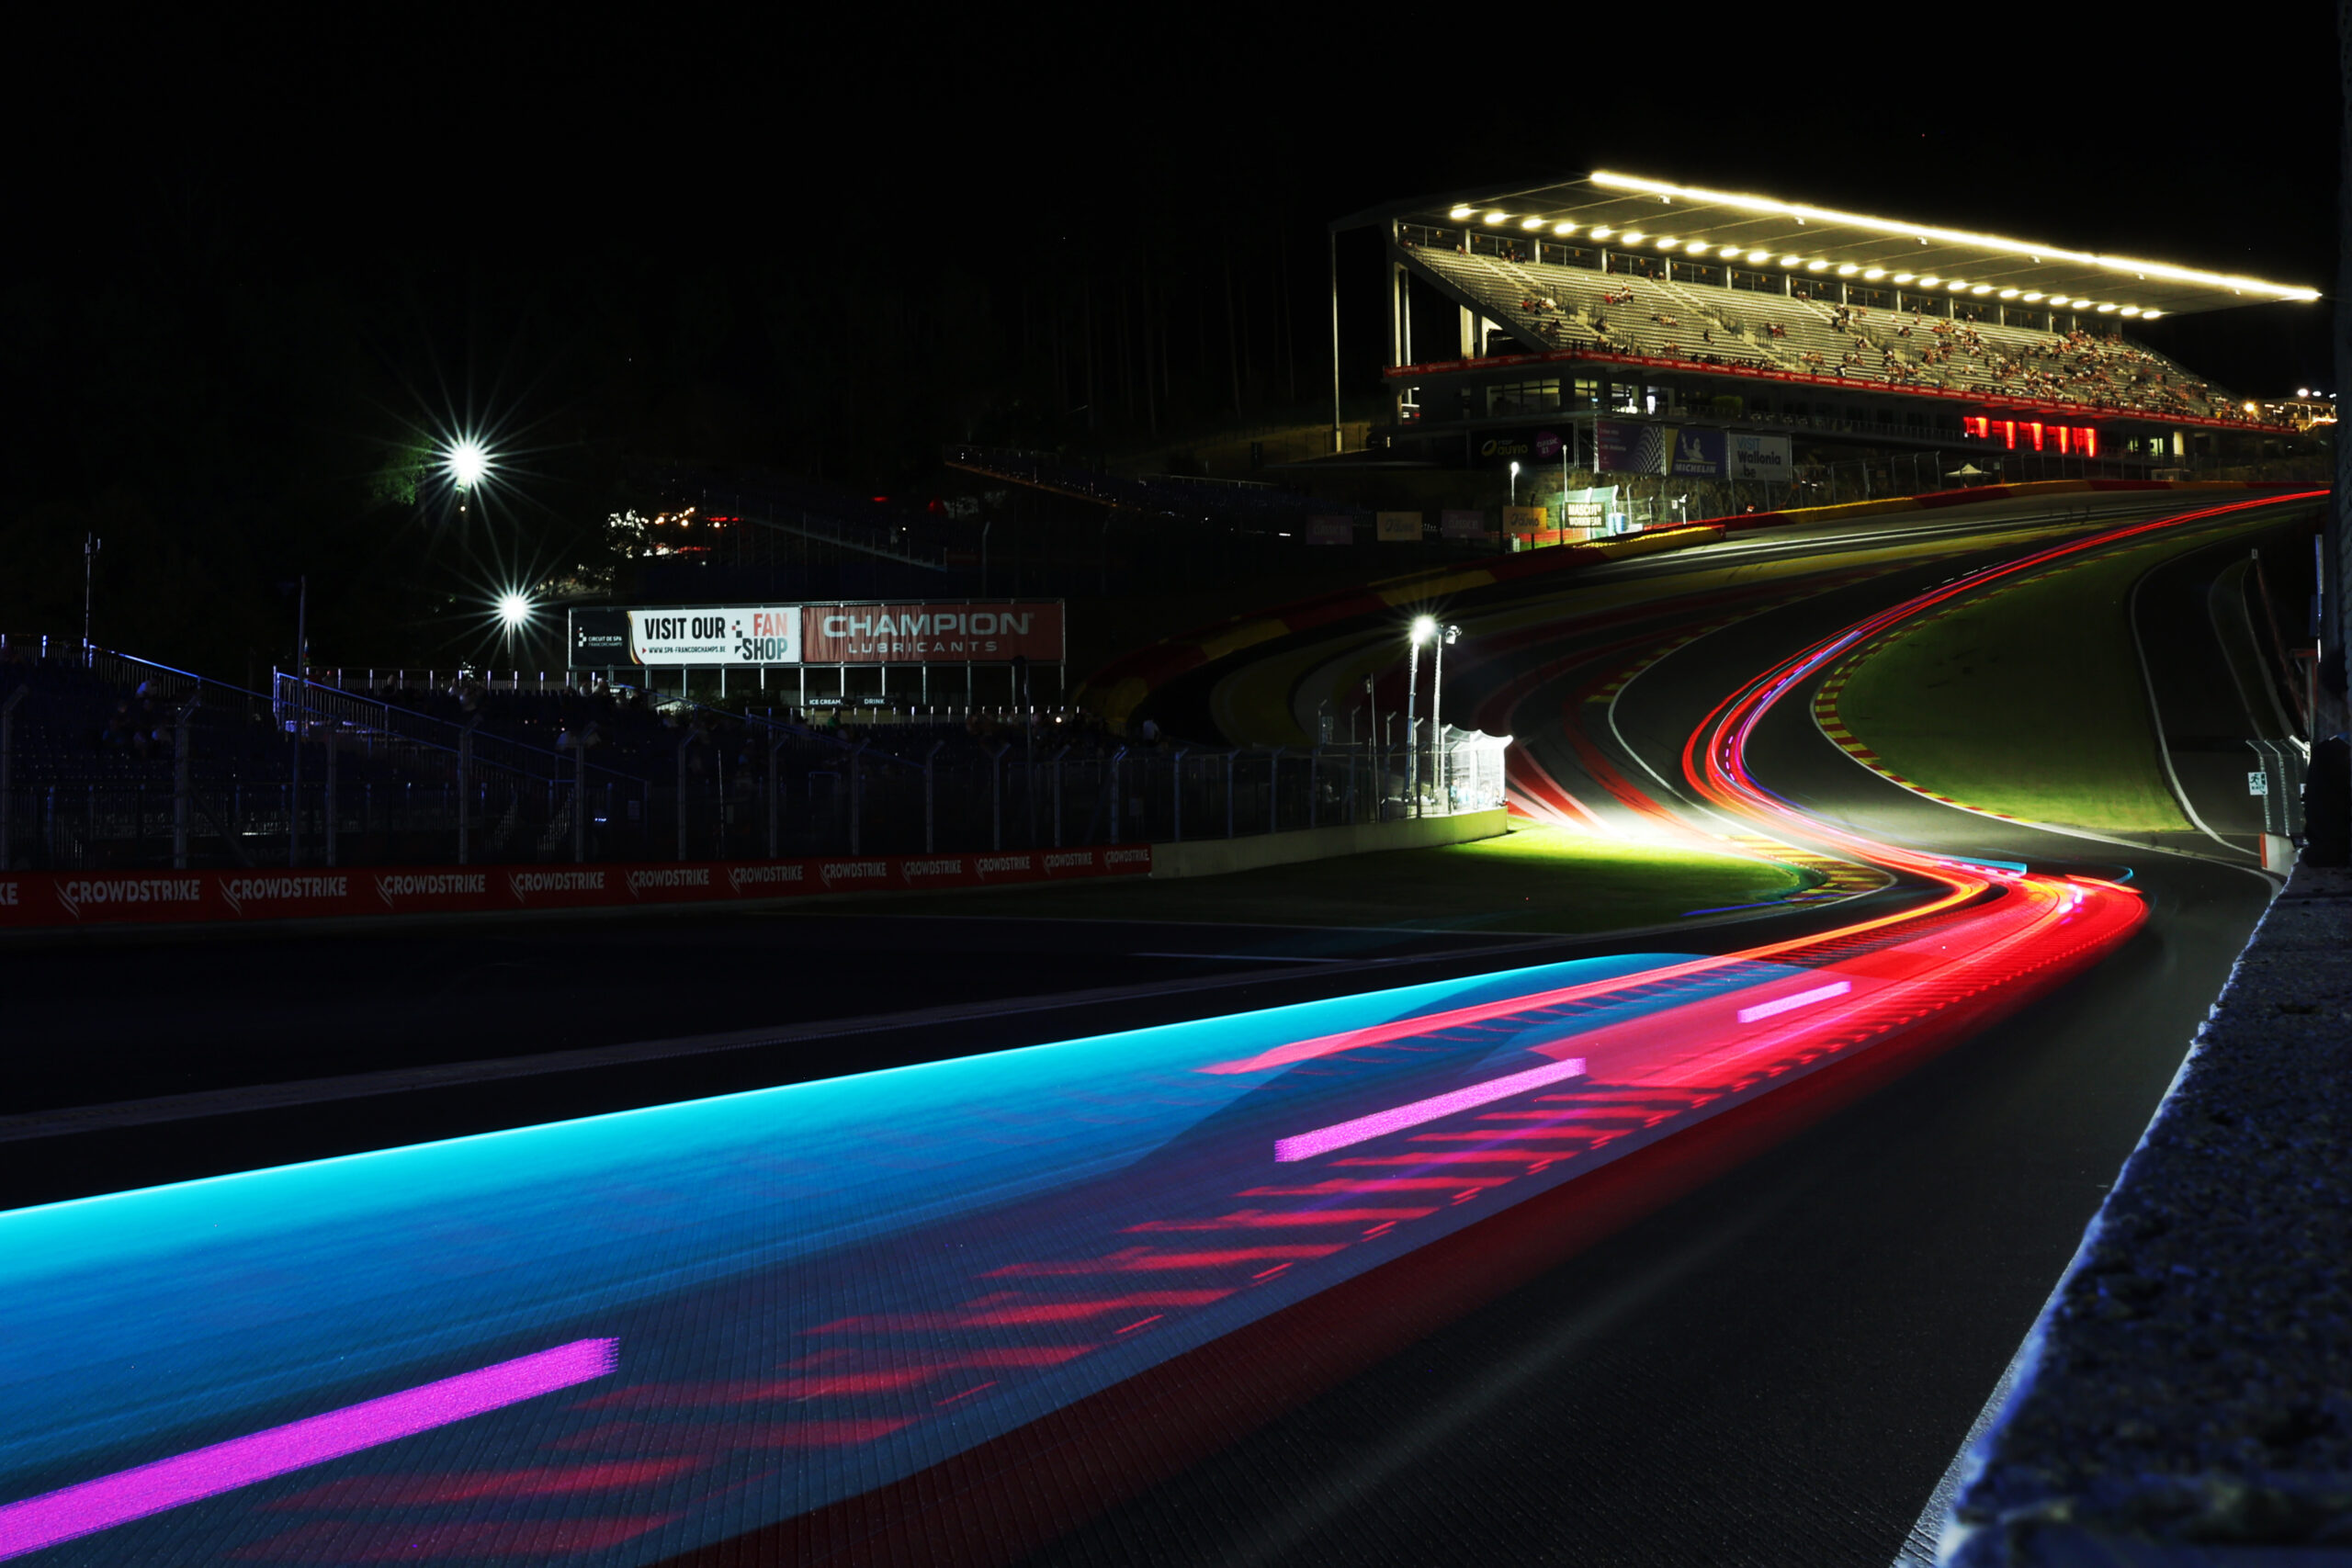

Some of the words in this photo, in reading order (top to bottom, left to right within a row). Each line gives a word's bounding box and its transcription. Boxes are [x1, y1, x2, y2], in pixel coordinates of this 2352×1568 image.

[1737, 450, 1781, 465] Wallonia
[1674, 463, 1716, 474] MICHELIN
[645, 618, 686, 639] VISIT
[692, 617, 726, 639] OUR
[753, 613, 787, 637] FAN
[823, 613, 1029, 637] CHAMPION
[742, 638, 788, 660] SHOP
[848, 641, 998, 654] LUBRICANTS
[978, 856, 1031, 873] CROWDSTRIKE
[1046, 852, 1092, 867] CROWDSTRIKE
[1106, 849, 1149, 864] CROWDSTRIKE
[733, 864, 804, 884] CROWDSTRIKE
[824, 862, 887, 879] CROWDSTRIKE
[905, 860, 961, 875] CROWDSTRIKE
[229, 876, 347, 900] CROWDSTRIKE
[383, 874, 485, 896] CROWDSTRIKE
[514, 872, 605, 892] CROWDSTRIKE
[632, 869, 709, 888] CROWDSTRIKE
[66, 879, 200, 903] CROWDSTRIKE
